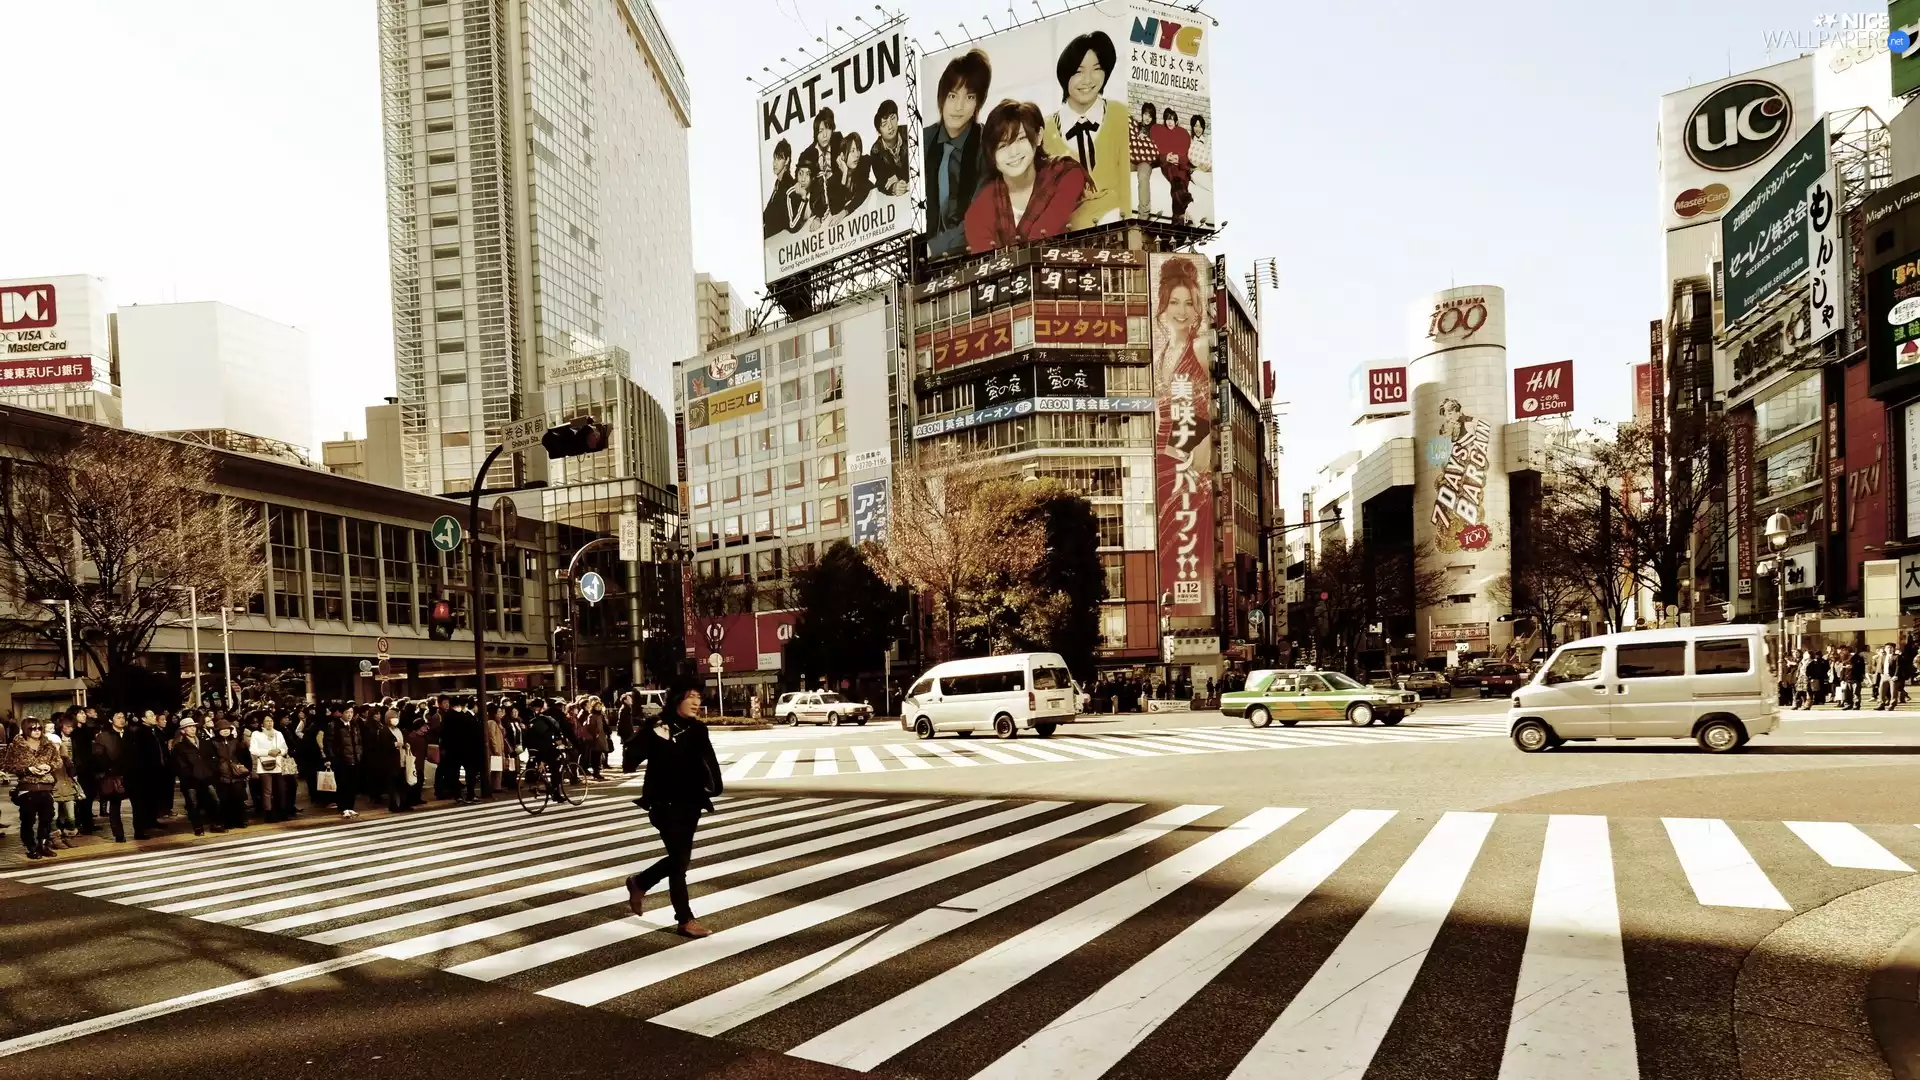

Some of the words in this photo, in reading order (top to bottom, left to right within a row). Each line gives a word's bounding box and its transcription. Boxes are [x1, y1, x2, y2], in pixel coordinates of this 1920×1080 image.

[1130, 16, 1203, 57] NYC
[763, 33, 900, 140] KAT-TUN
[1131, 66, 1169, 86] 2010.10.20
[1170, 74, 1198, 91] RELEASE
[1675, 191, 1729, 210] MasterCard
[1865, 203, 1893, 225] Mighty
[778, 231, 825, 265] CHANGE
[828, 224, 844, 245] UR
[848, 203, 896, 237] WORLD
[872, 223, 895, 236] RELEASE
[1810, 184, 1834, 329] もんじゃ
[1435, 297, 1485, 310] SHIBUYA
[1035, 319, 1124, 338] コンタクト
[1425, 304, 1487, 340] 109
[17, 330, 42, 341] VISA
[50, 330, 57, 339] &
[7, 340, 66, 353] MasterCard
[935, 327, 1010, 363] プライス
[0, 364, 83, 380] 菱東京UFJ銀行
[1373, 372, 1400, 385] UNI
[1526, 367, 1561, 392] H&M
[748, 392, 758, 404] 4F
[1374, 386, 1402, 402] QLO
[1040, 399, 1069, 409] AEON
[1075, 399, 1152, 410] 英会話イーオン
[1540, 401, 1567, 410] 150m
[945, 406, 1013, 430] 英会話イーオン
[505, 419, 543, 441] 渋谷駅前
[916, 422, 940, 436] AEON
[512, 438, 529, 448] Shibuya
[1457, 419, 1491, 526] BARGAIN
[1177, 583, 1198, 593] 1.12
